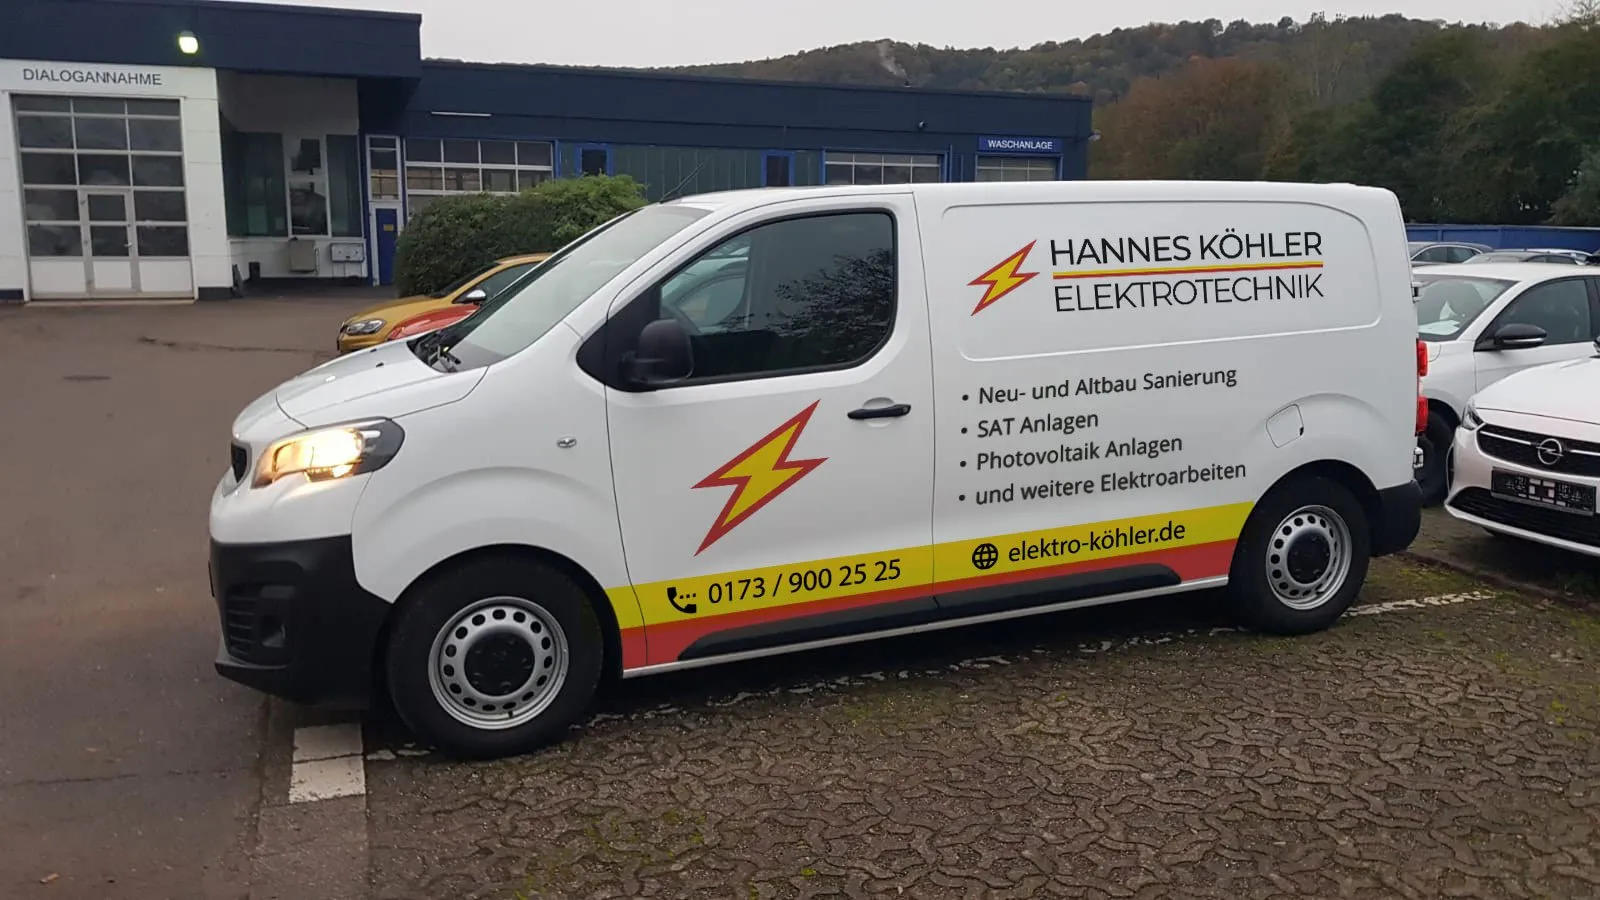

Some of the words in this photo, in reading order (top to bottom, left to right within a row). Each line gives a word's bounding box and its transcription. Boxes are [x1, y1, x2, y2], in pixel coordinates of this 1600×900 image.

[23, 68, 162, 85] DIALOGANNAHME
[987, 139, 1053, 150] WASCHANLAGE
[1050, 235, 1191, 266] HANNES
[1199, 228, 1322, 260] KÖHLER
[1054, 273, 1324, 312] ELEKTROTECHNIK
[979, 387, 1026, 404] Neu-
[1032, 380, 1069, 398] und
[1075, 376, 1137, 396] Altbau
[1143, 368, 1238, 390] Sanierung
[977, 418, 1015, 438] SAT
[1019, 412, 1099, 434] Anlagen
[976, 443, 1100, 470] Photovoltaik
[1105, 436, 1183, 459] Anlagen
[975, 483, 1014, 505] und
[1021, 477, 1094, 500] weitere
[1100, 463, 1246, 492] Elektroarbeiten
[1008, 520, 1186, 562] elektro-köhler.de
[708, 577, 766, 605] 0173
[789, 568, 832, 594] 900
[839, 564, 867, 587] 25
[874, 559, 901, 581] 25
